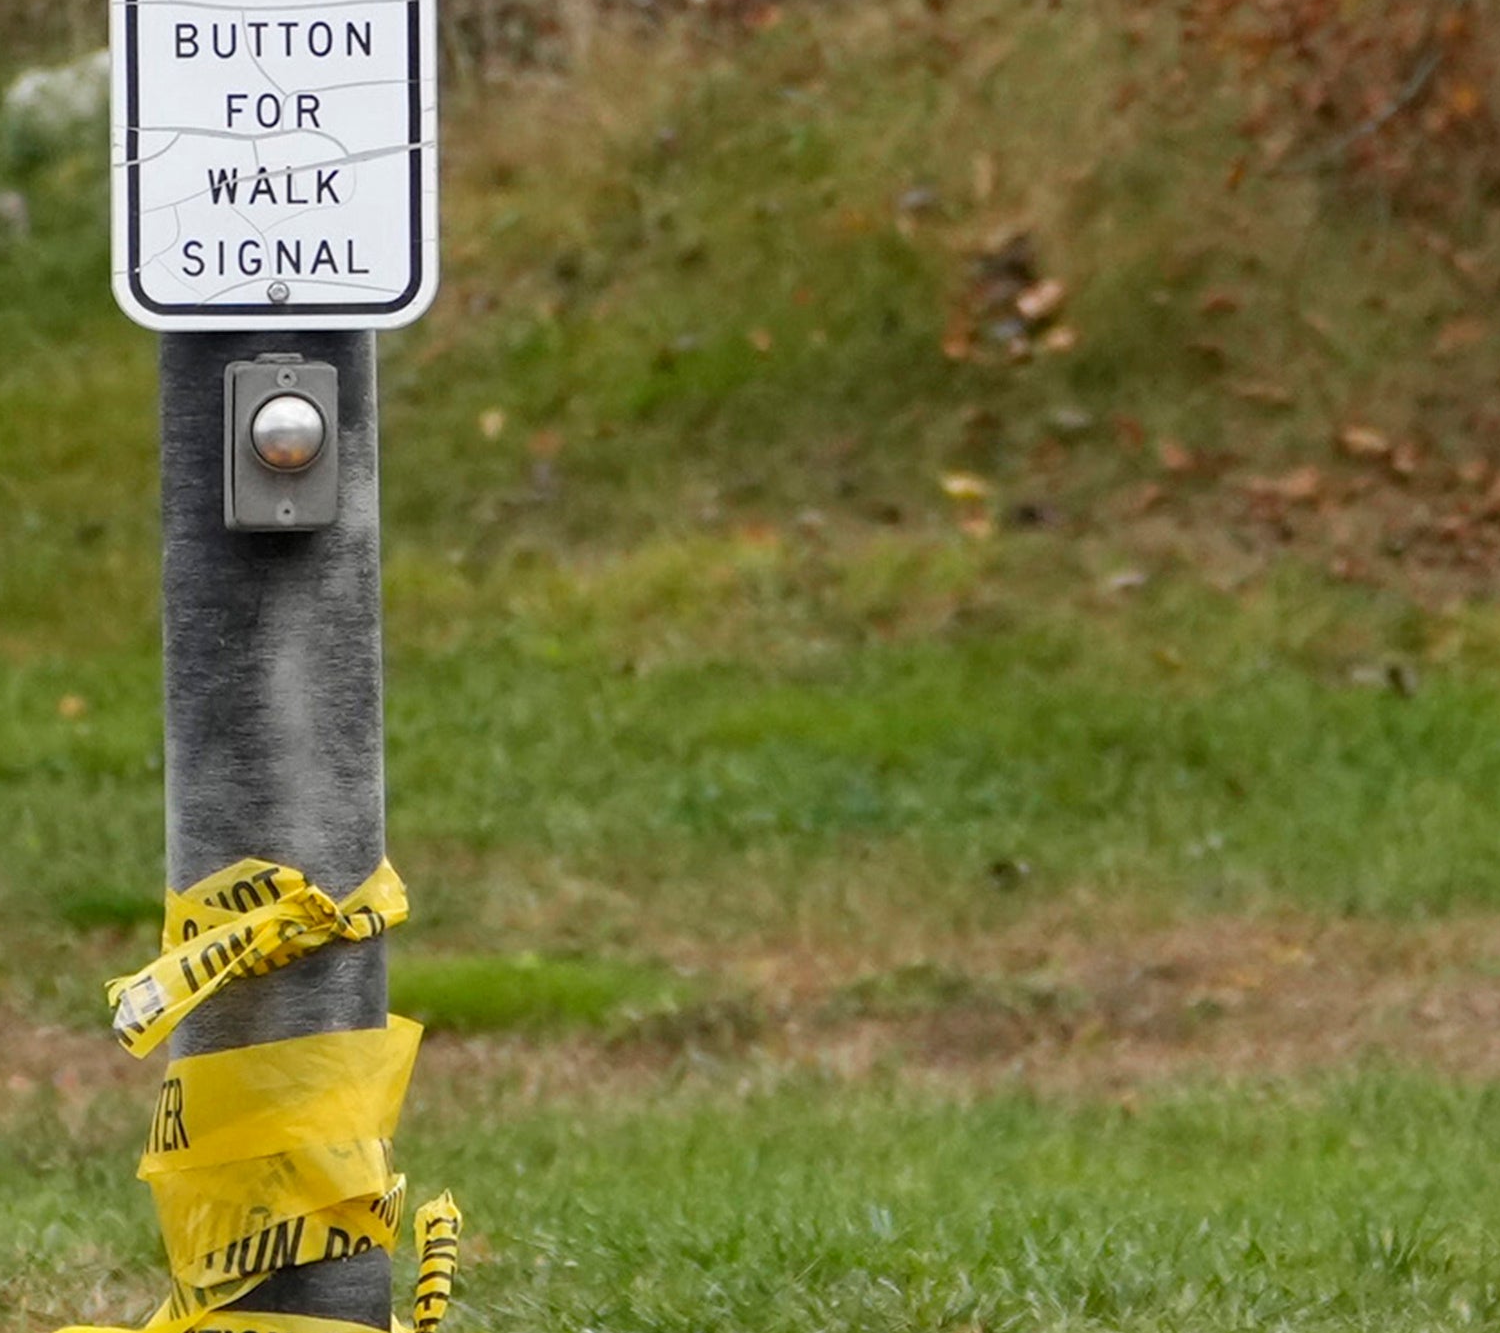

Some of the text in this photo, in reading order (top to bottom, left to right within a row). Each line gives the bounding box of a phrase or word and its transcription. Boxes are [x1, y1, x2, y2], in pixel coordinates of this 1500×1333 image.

[175, 21, 372, 59] BUTTON
[226, 93, 321, 129] FOR
[208, 166, 341, 205] WALK
[182, 239, 370, 276] SIGNAL
